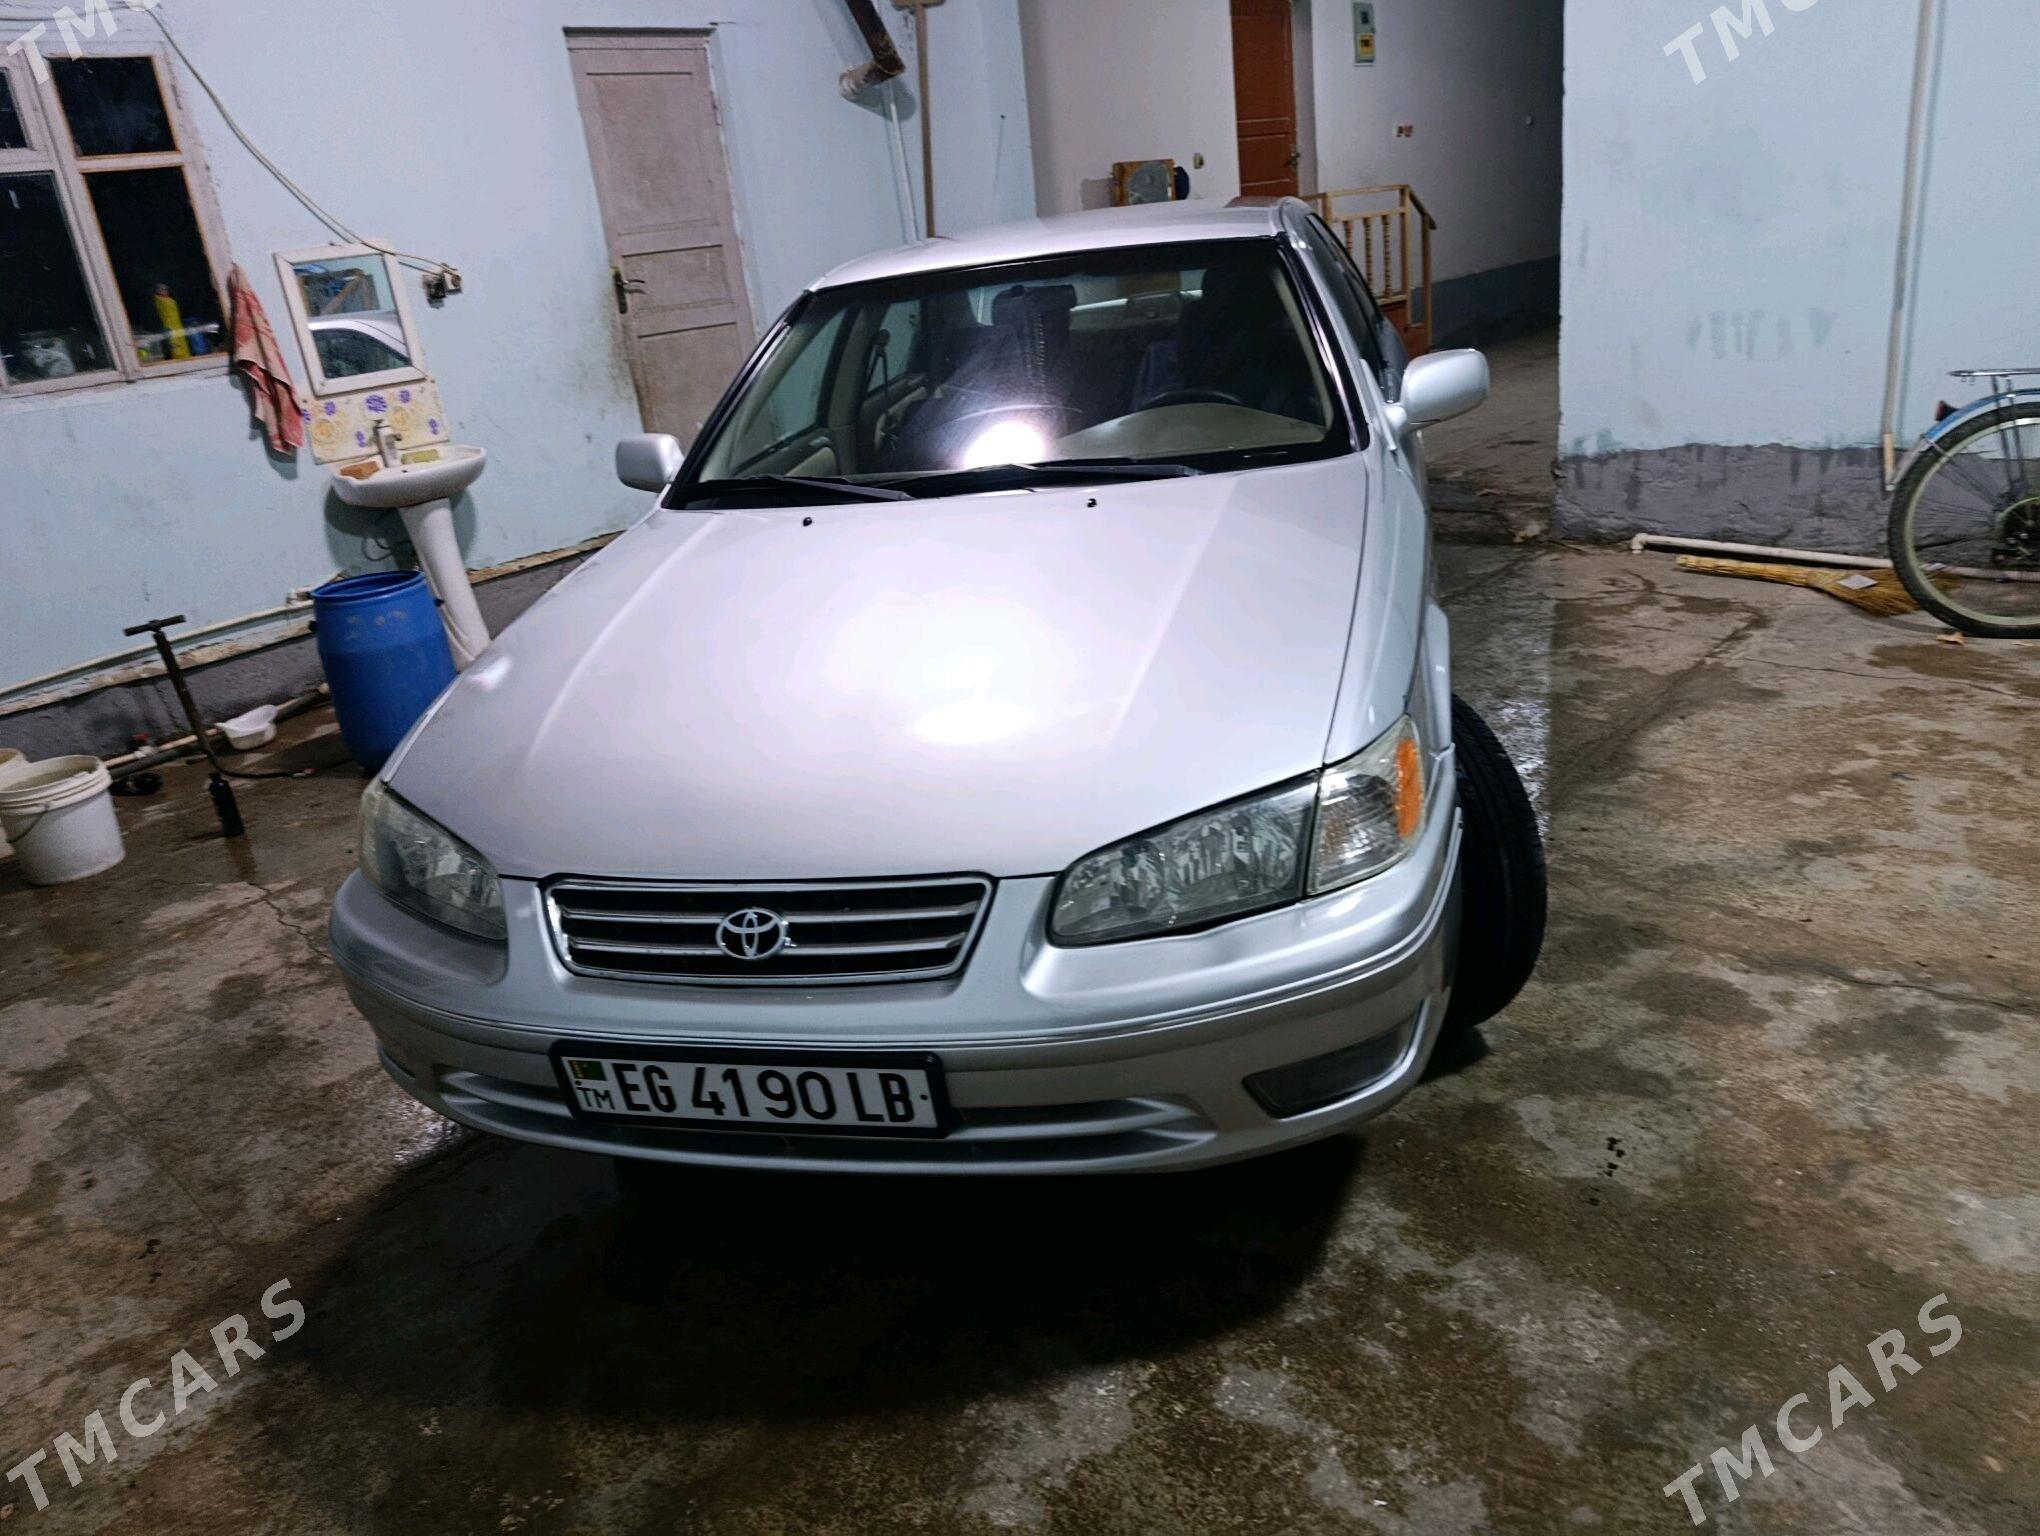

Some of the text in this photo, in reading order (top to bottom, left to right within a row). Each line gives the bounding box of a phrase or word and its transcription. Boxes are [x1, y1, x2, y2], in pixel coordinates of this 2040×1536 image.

[578, 1086, 616, 1110] TM
[611, 1062, 915, 1123] EG 4190 LB
